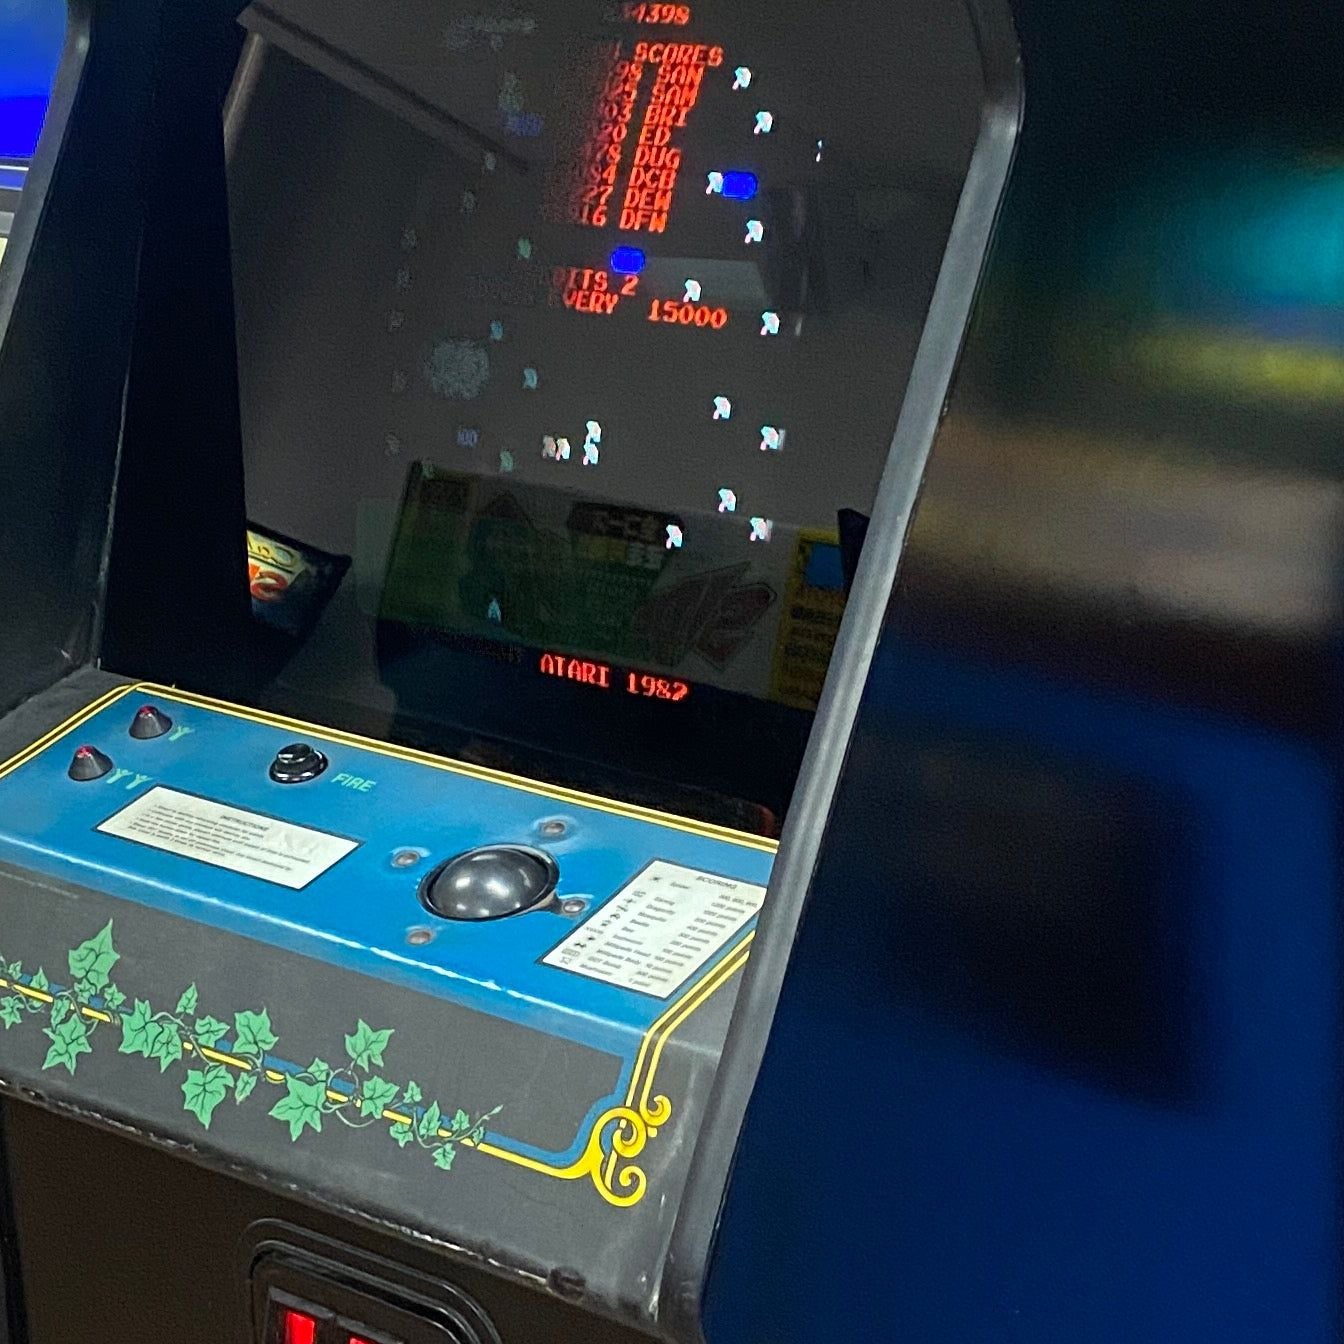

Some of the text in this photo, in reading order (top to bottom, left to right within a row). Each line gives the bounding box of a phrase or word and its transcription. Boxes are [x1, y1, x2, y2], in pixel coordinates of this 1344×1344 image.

[635, 41, 724, 67] SCORES
[620, 274, 640, 296] 2
[648, 298, 728, 329] 15000
[540, 653, 610, 688] ATARI
[331, 772, 376, 793] FIRE
